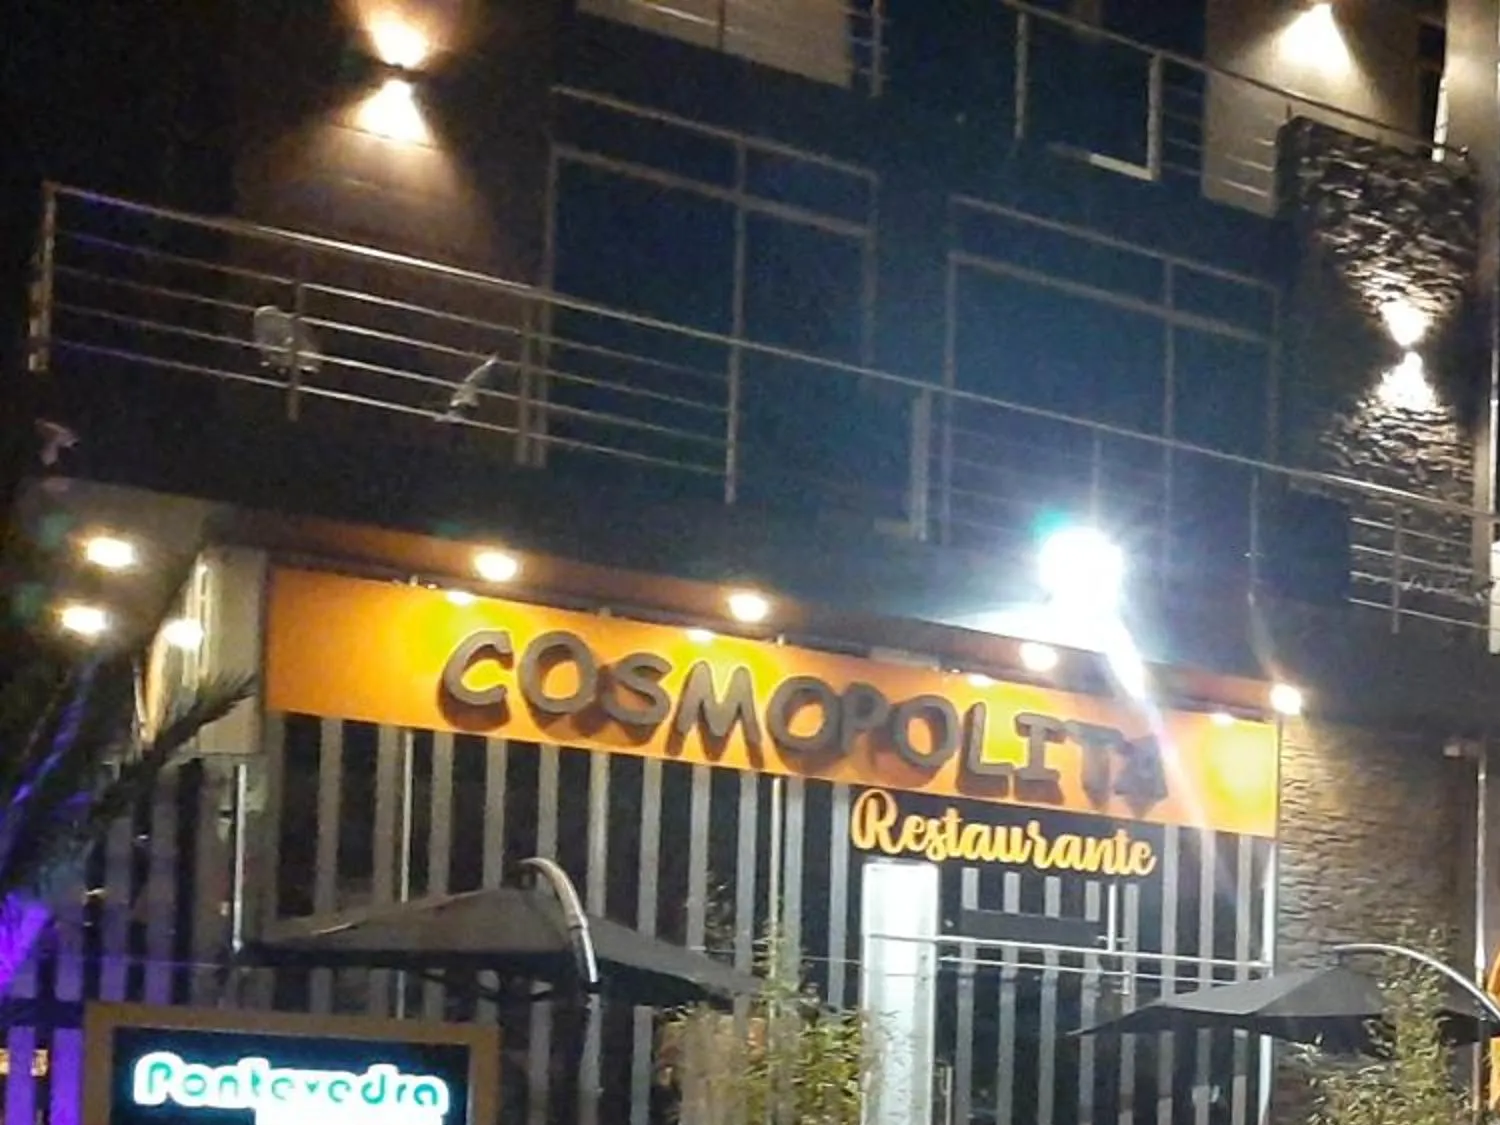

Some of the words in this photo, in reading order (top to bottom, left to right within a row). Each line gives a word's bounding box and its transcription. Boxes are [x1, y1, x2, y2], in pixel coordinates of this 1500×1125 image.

[440, 629, 1168, 808] COSMOPOLITA
[851, 789, 1157, 876] Restaurante
[140, 1056, 446, 1111] Pontevedra
